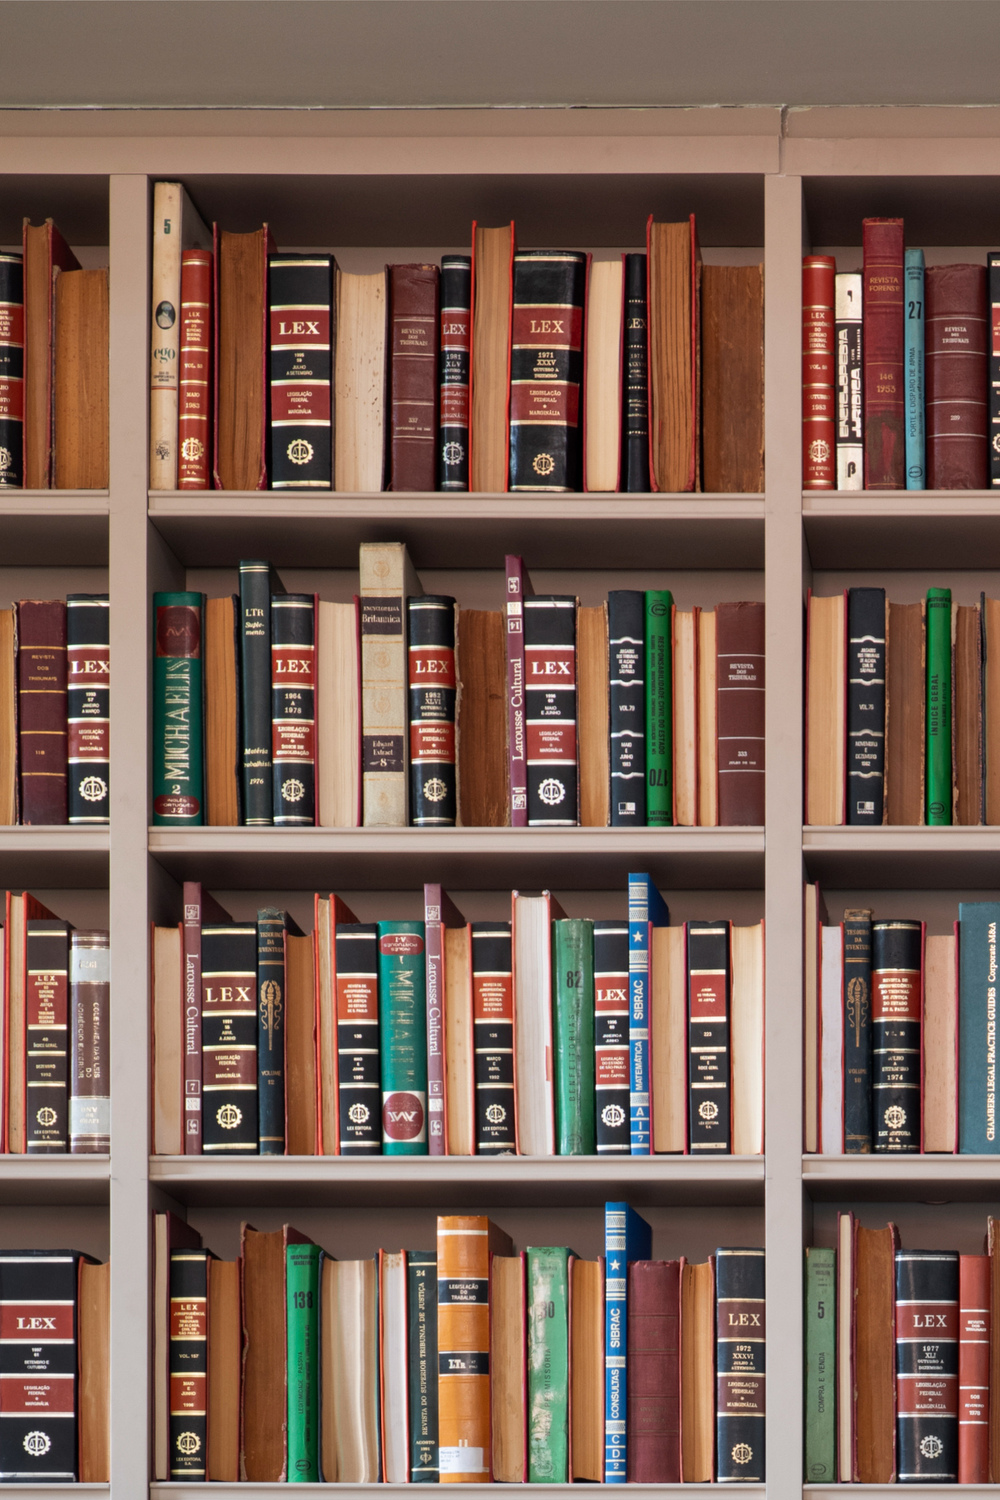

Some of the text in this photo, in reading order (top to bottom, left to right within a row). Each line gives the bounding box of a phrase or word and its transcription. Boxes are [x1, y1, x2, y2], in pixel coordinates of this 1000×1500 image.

[164, 219, 171, 234] 5
[869, 277, 899, 285] REVISTA
[869, 285, 900, 293] FORENSE
[908, 301, 922, 320] 27
[279, 321, 320, 335] LEX
[442, 324, 467, 336] LEX
[530, 320, 565, 334] LEX
[362, 613, 401, 625] Britannica
[71, 659, 110, 674] LEX
[275, 659, 312, 674] LEX
[415, 660, 449, 674] LEX
[531, 661, 571, 675] LEX
[285, 706, 302, 714] 1978
[511, 658, 524, 761] Larousse Cultural
[163, 660, 191, 781] MICHAELIS
[649, 769, 670, 787] 170
[171, 784, 181, 795] 2
[987, 922, 998, 983] Corporate M&A
[566, 971, 583, 989] 82
[205, 987, 252, 1003] LEX
[596, 989, 627, 1002] LEX
[633, 979, 644, 1020] SIBRAC
[186, 953, 199, 1055] Larousse Cultural
[428, 954, 441, 1057] Larousse Cultural
[634, 1040, 643, 1091] MATEMÁTICA
[986, 987, 996, 1141] CHAMBERS LEGAL PRACTICE GUIDES
[432, 1083, 440, 1093] 5
[448, 1283, 479, 1291] LEGISLAÇÃO
[293, 1291, 313, 1309] 138
[817, 1301, 826, 1320] 5
[16, 1317, 57, 1330] LEX
[728, 1313, 761, 1327] LEX
[913, 1314, 948, 1328] LEX
[610, 1307, 621, 1349] SIBRAC
[610, 1369, 620, 1419] CONSULTAS
[611, 1434, 621, 1445] C
[612, 1449, 620, 1459] D
